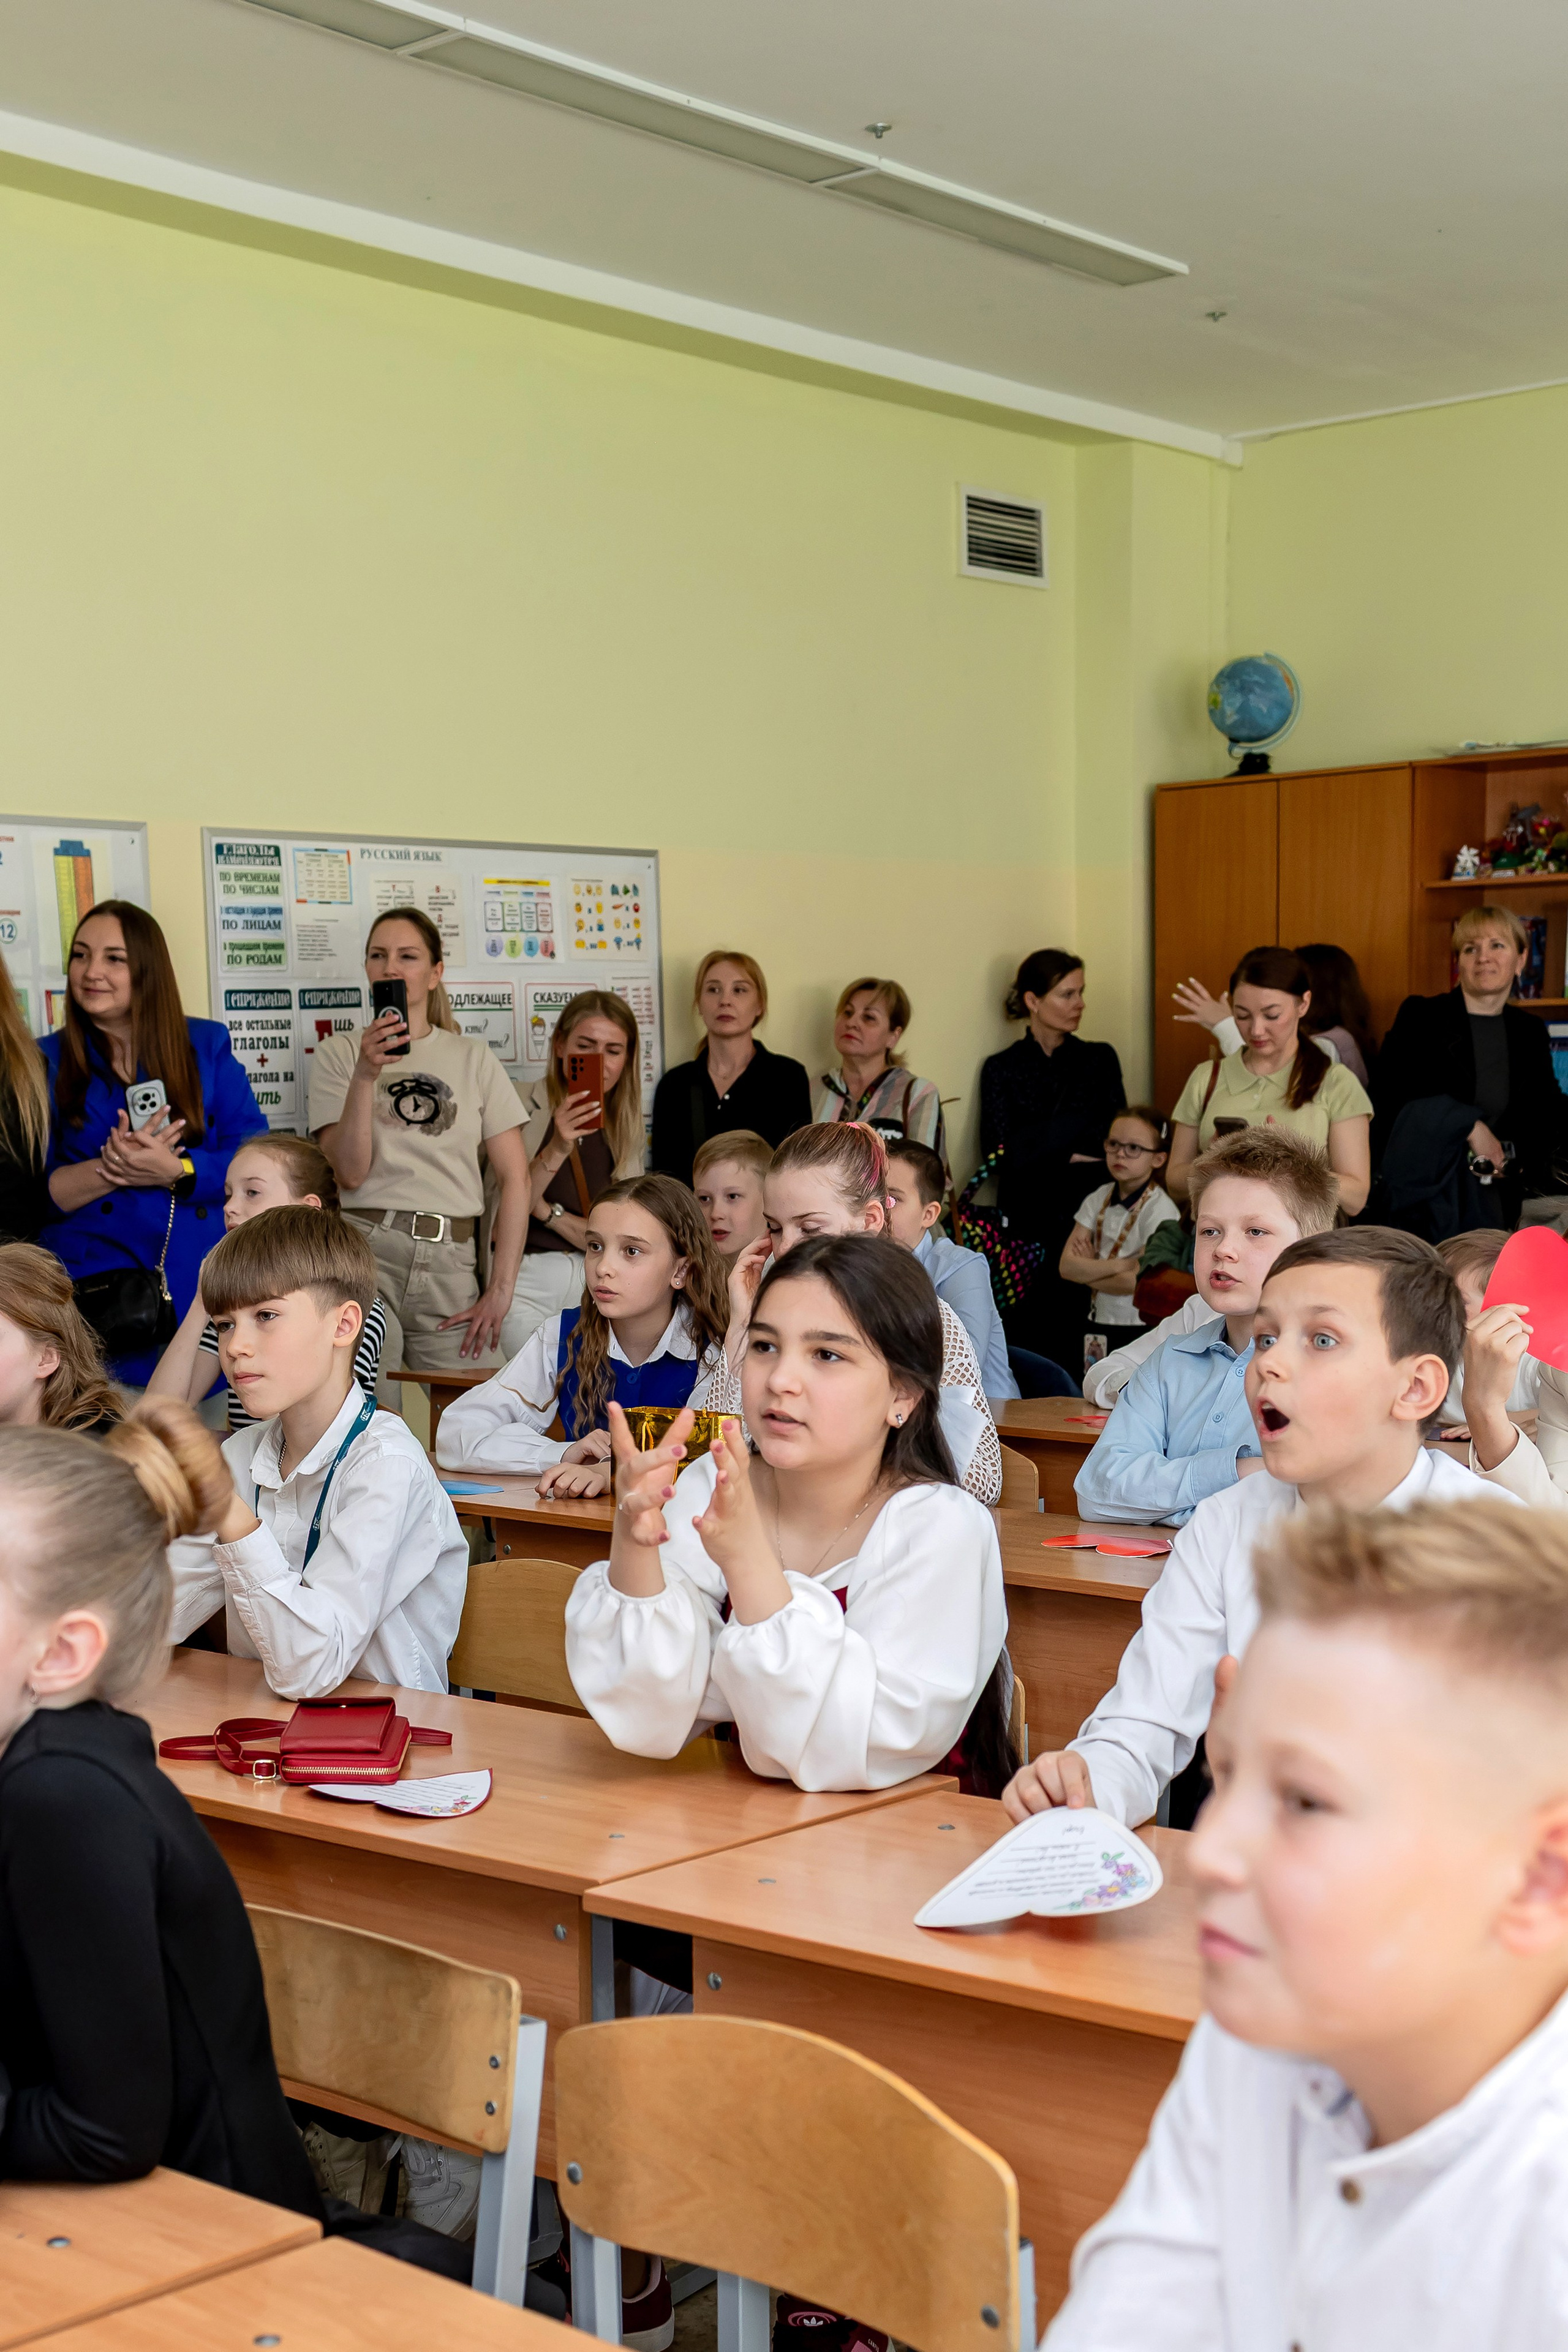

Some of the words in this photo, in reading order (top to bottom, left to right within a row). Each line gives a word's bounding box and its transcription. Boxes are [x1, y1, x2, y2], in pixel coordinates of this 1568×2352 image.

[360, 847, 411, 861] РУССКИЙ
[413, 850, 442, 862] ЯЗЫК
[220, 872, 231, 881] ПО
[223, 884, 236, 894] ПО
[239, 884, 279, 895] ЧИСЛАМ
[222, 919, 238, 930] ПО
[241, 919, 282, 930] ЛИЦАМ
[227, 954, 242, 965] ПО
[246, 954, 282, 965] РОДАМ
[448, 993, 512, 1008] ОДЛЕЖАЩЕЕ
[246, 1019, 292, 1031] остальные
[232, 1036, 289, 1050] глаголы
[246, 1071, 280, 1084] лагола
[283, 1071, 294, 1082] на
